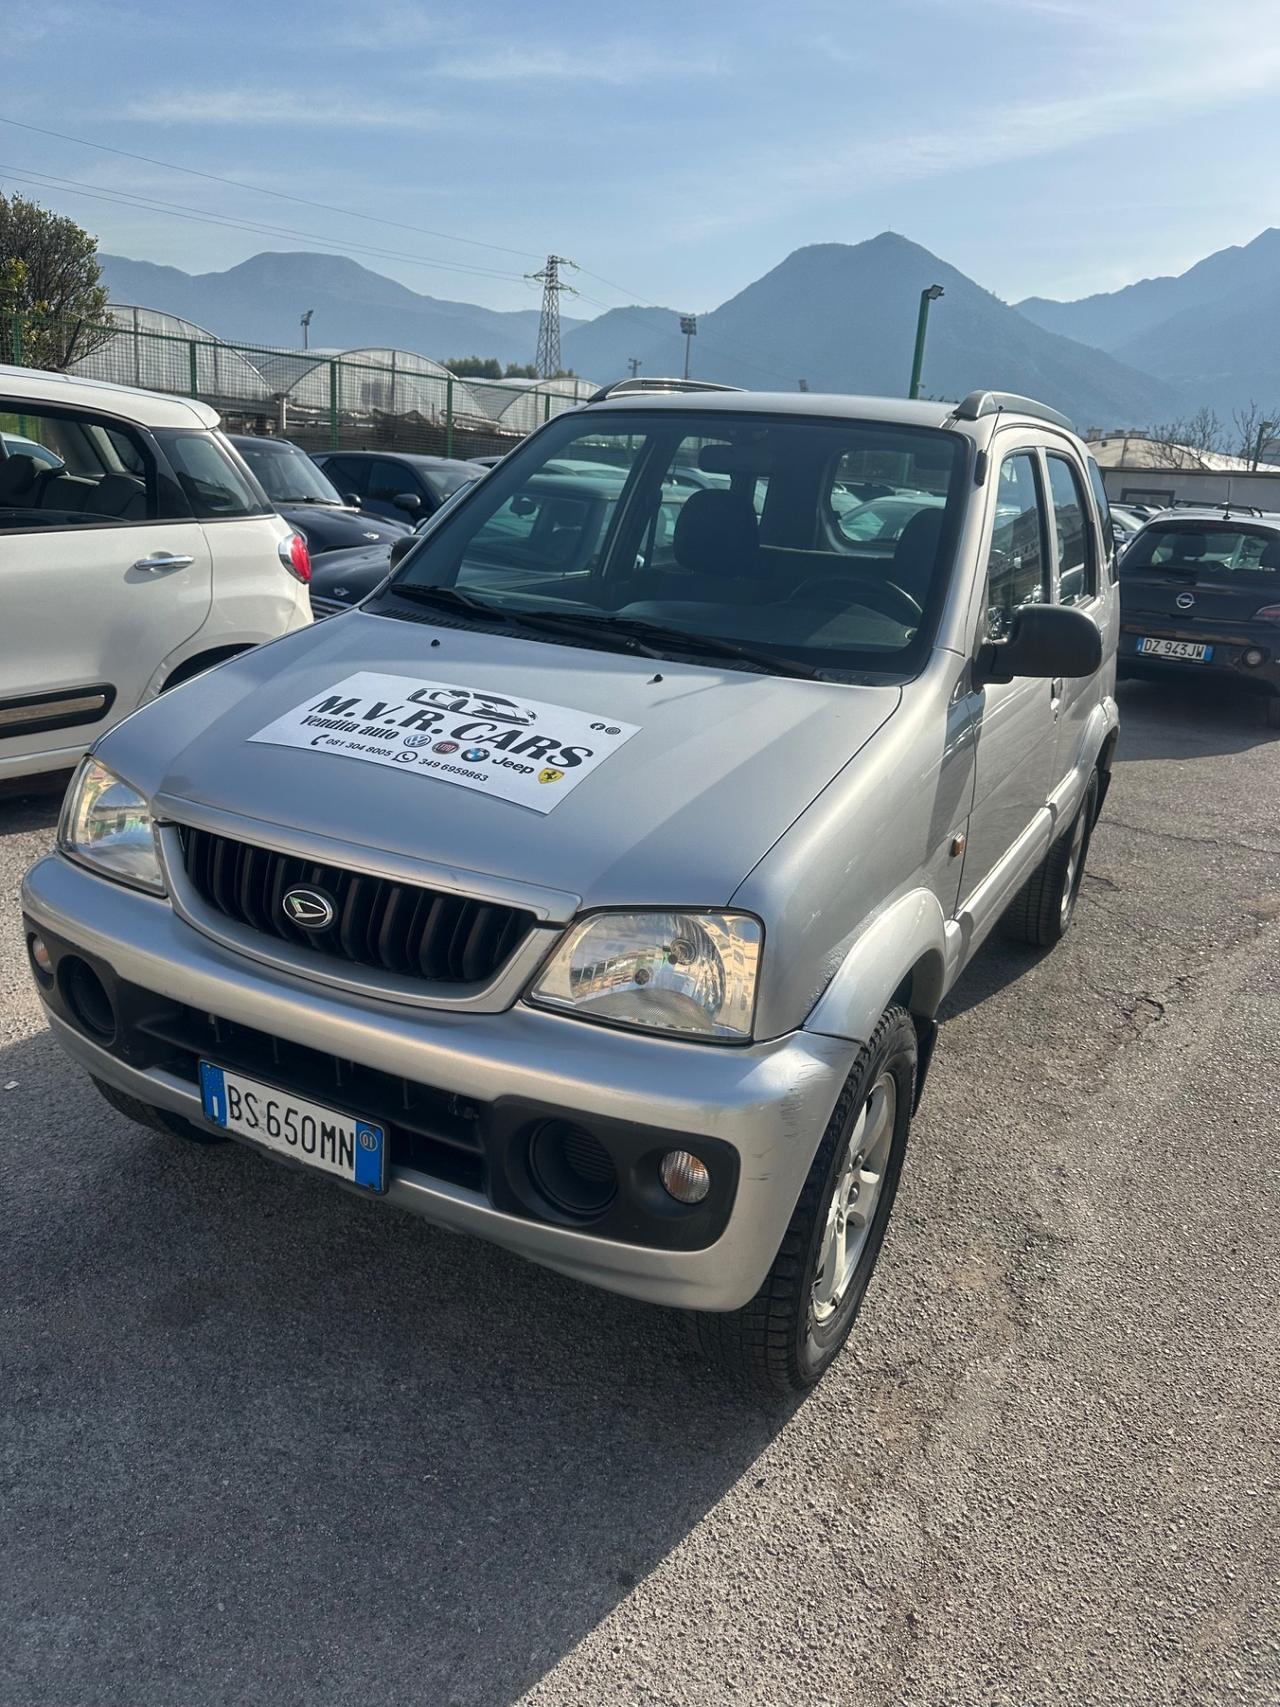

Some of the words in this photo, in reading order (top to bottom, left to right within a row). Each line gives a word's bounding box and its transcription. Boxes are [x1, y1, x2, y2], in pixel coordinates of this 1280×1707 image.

[1144, 639, 1161, 652] DZ
[300, 715, 361, 733] Vendita
[358, 725, 400, 740] auto
[325, 738, 346, 746] 081
[345, 742, 366, 751] 304
[365, 746, 393, 757] 8005
[418, 758, 441, 768] 349
[440, 763, 489, 782] 6959863
[491, 757, 535, 774] Jeep
[227, 1084, 260, 1129] BS
[265, 1100, 354, 1171] 650MN
